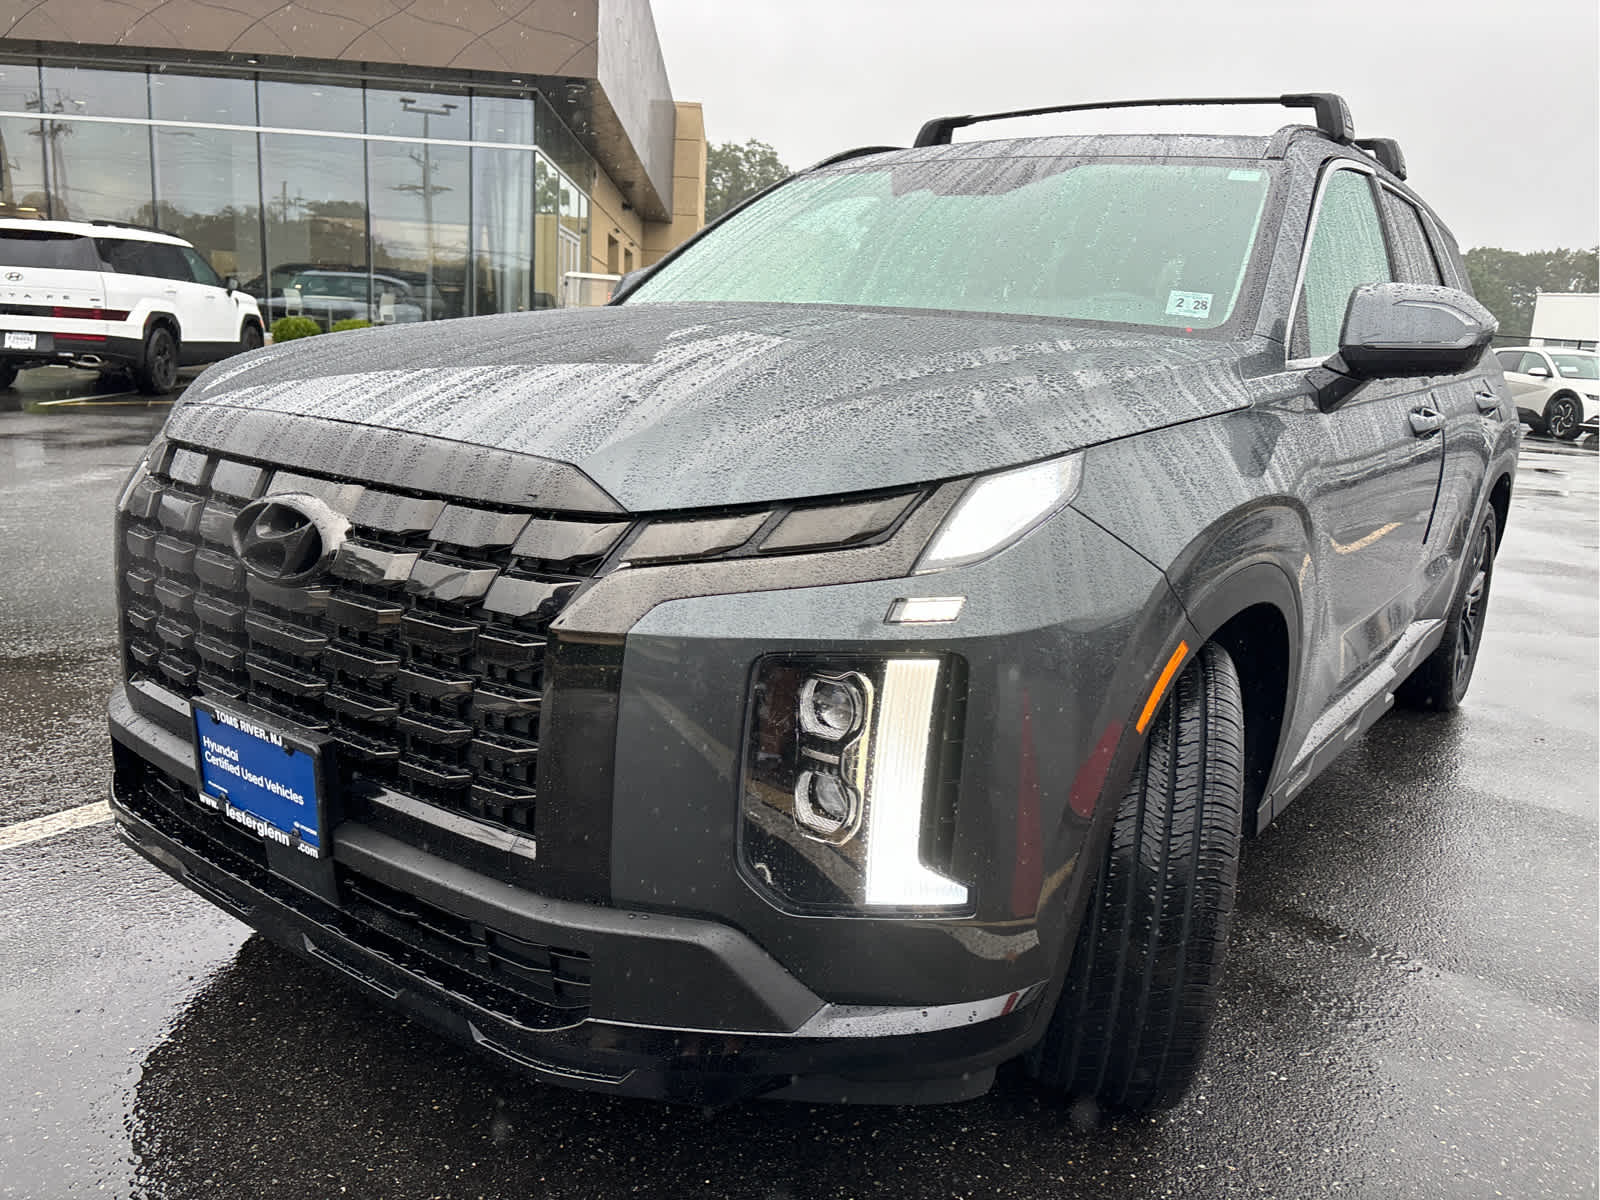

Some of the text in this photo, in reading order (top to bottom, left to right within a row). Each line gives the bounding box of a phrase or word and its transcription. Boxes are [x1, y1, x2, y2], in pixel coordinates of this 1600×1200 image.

[1176, 298, 1208, 310] 2 28
[214, 709, 283, 746] TOMS RIVER, NJ
[202, 736, 239, 762] Hyundai
[204, 751, 241, 777] Certified
[240, 766, 264, 788] Used
[264, 778, 305, 806] Vehicles
[225, 803, 290, 847] lesterglenn
[297, 845, 319, 859] .com
